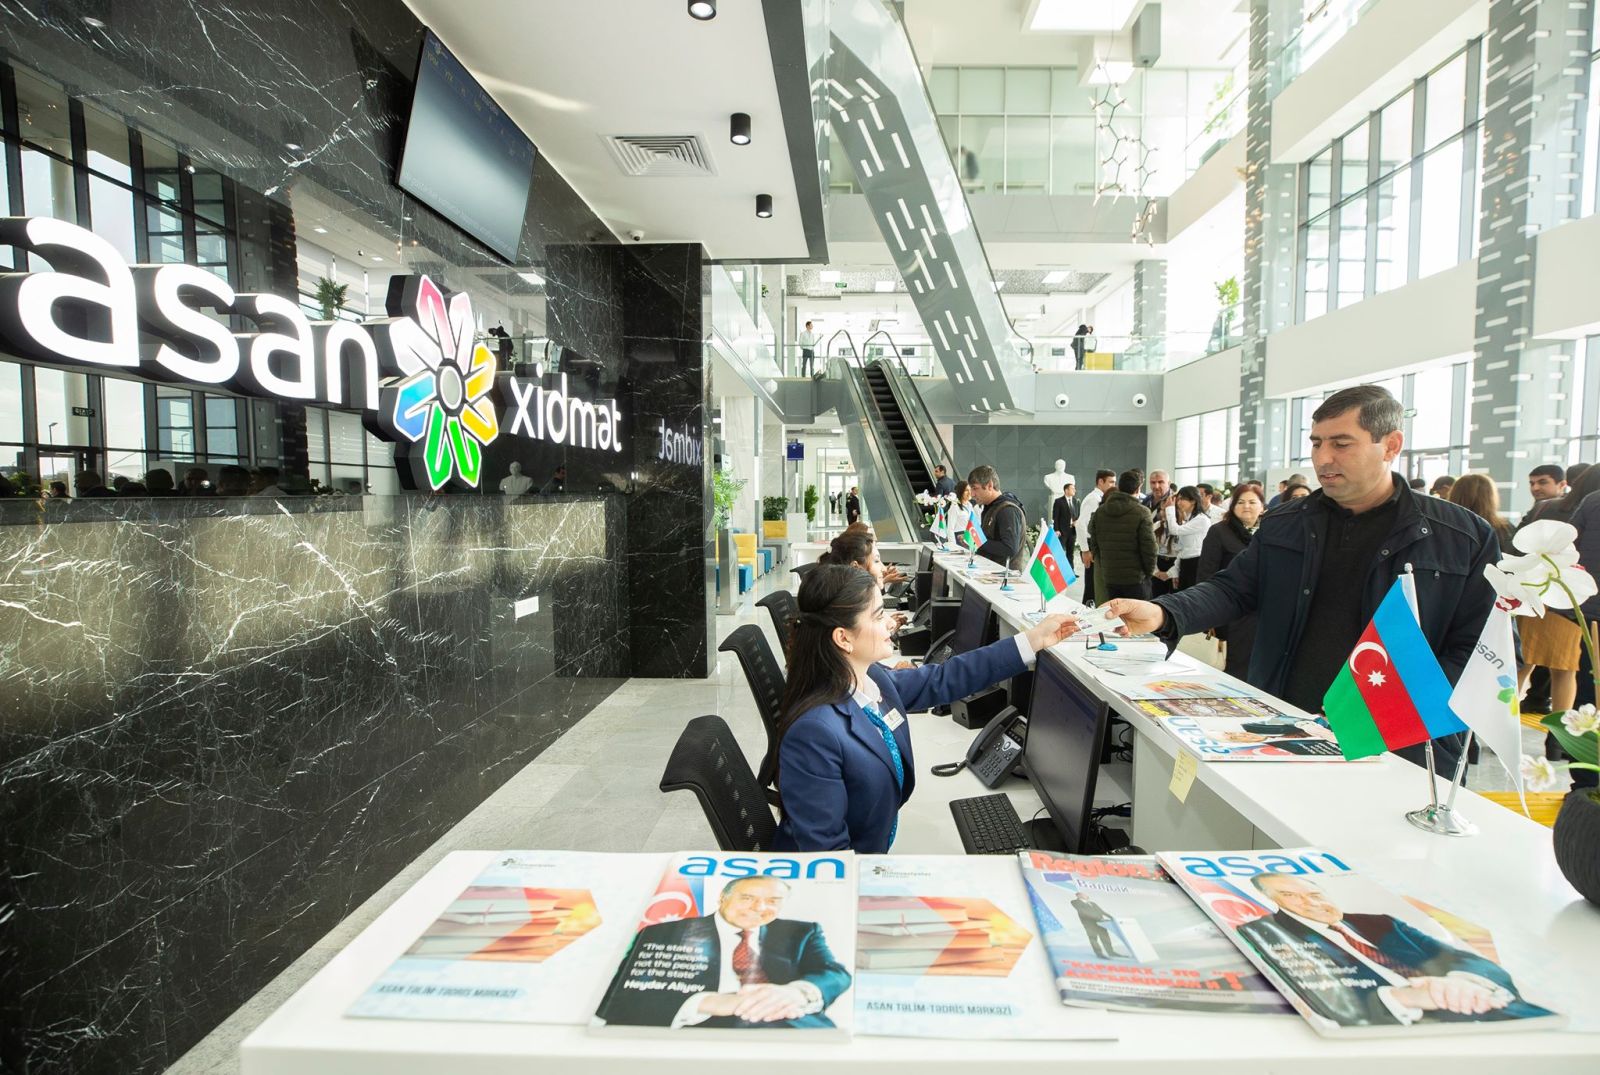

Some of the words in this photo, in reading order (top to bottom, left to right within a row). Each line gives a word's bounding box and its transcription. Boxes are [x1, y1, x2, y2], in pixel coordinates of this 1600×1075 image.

[18, 217, 379, 410] asan
[510, 362, 622, 453] xidmət
[678, 856, 846, 879] asan
[1029, 852, 1150, 879] Region
[1179, 853, 1352, 878] asan
[866, 1001, 893, 1012] ASAN
